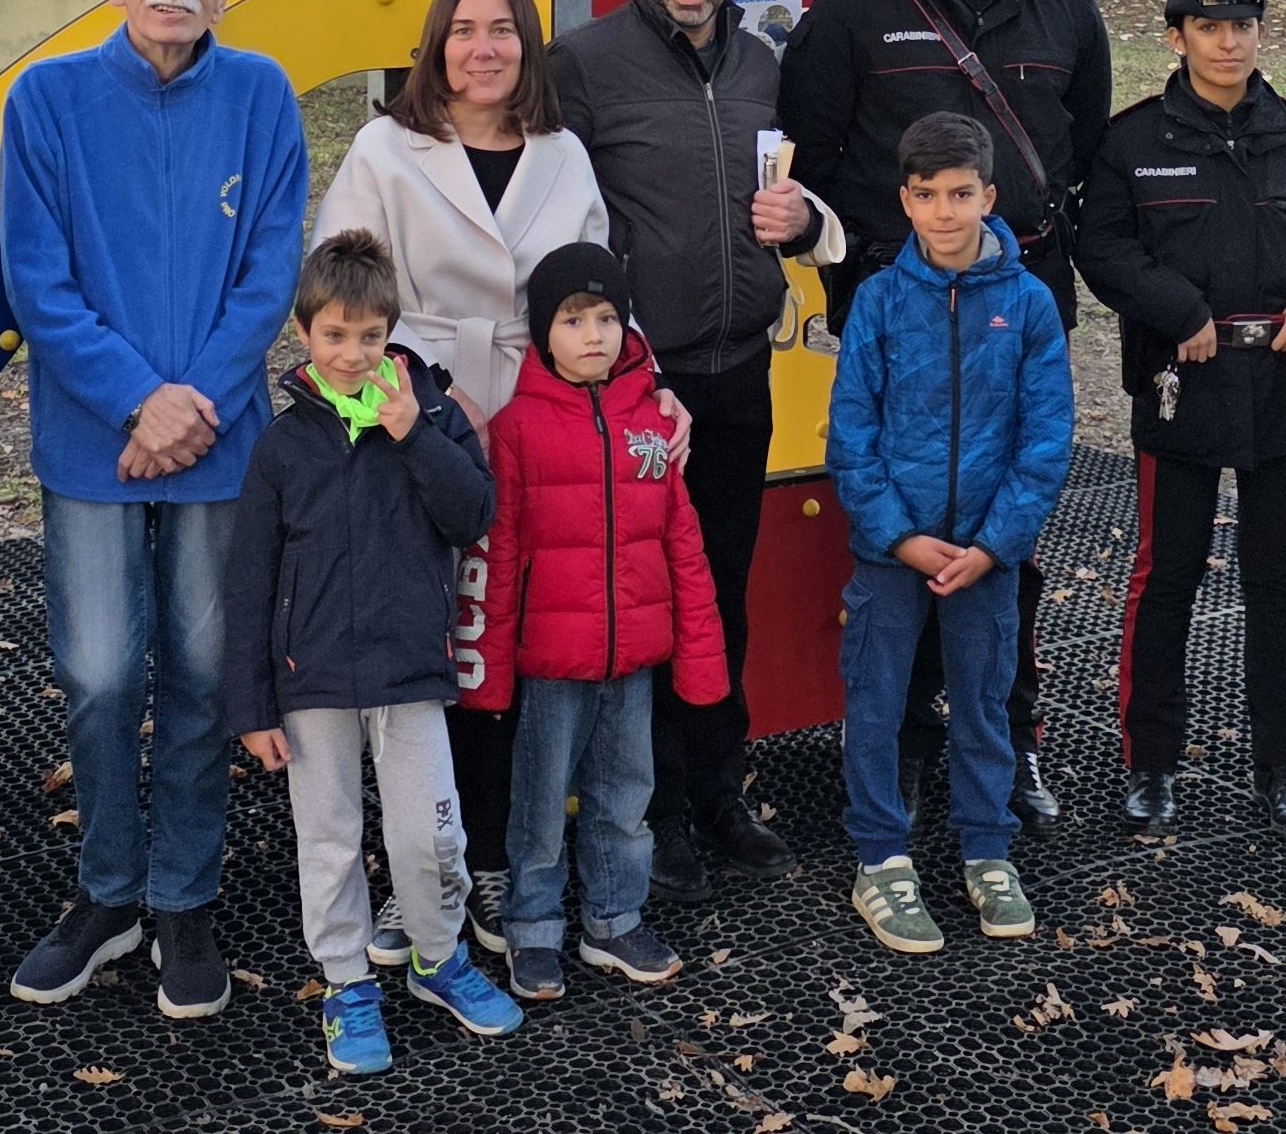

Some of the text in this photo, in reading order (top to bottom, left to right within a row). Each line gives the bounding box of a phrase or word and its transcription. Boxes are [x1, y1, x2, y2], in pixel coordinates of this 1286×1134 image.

[882, 30, 942, 44] CARABINIER
[1134, 166, 1197, 177] CARABINIERI
[636, 445, 668, 480] 76
